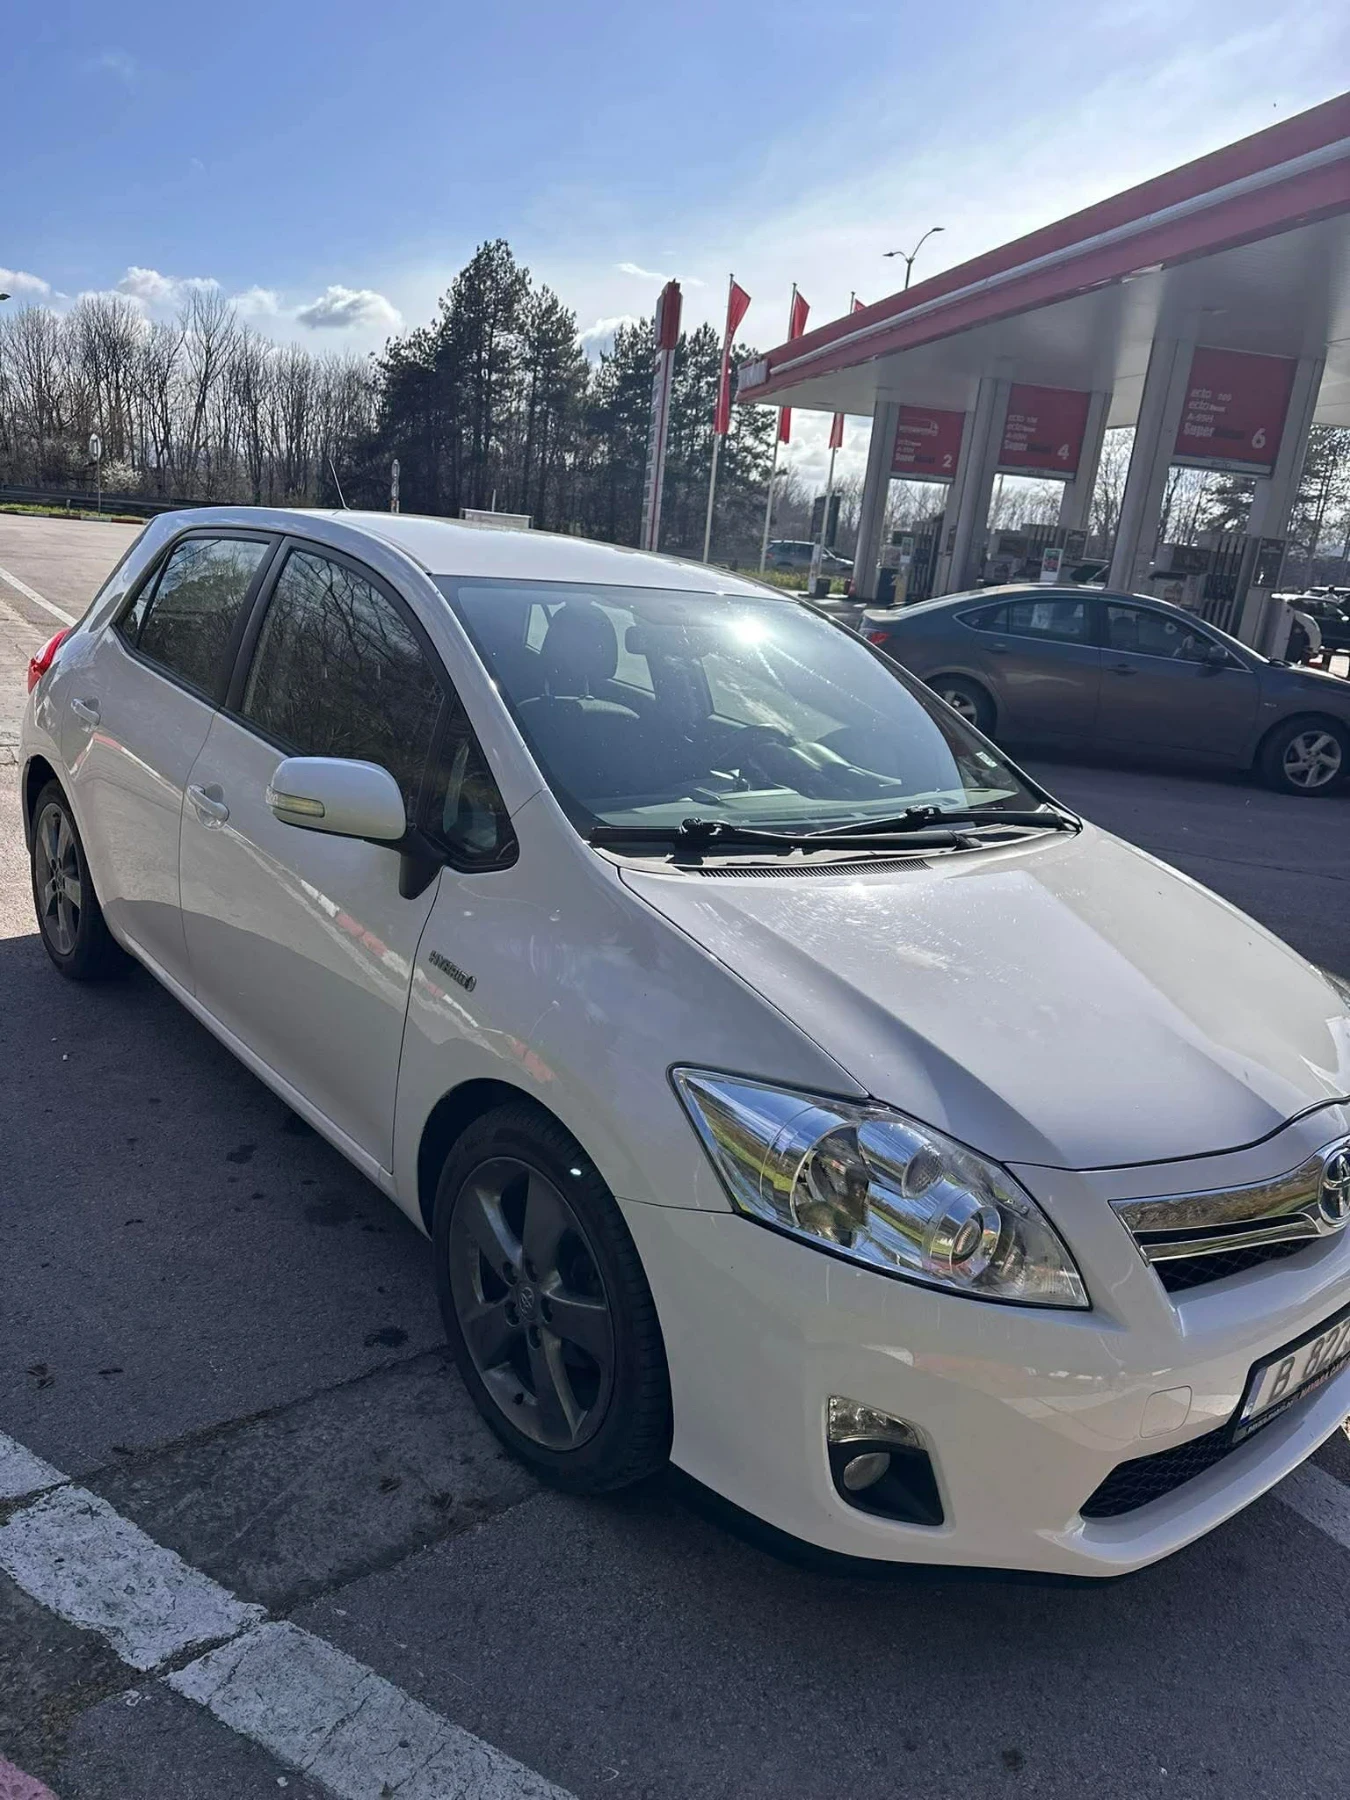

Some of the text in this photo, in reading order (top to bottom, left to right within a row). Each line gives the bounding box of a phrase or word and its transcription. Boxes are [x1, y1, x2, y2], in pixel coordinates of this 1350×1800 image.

[1251, 427, 1267, 449] 6
[942, 453, 953, 468] 2
[1057, 443, 1070, 460] 4
[1268, 1356, 1296, 1404] B
